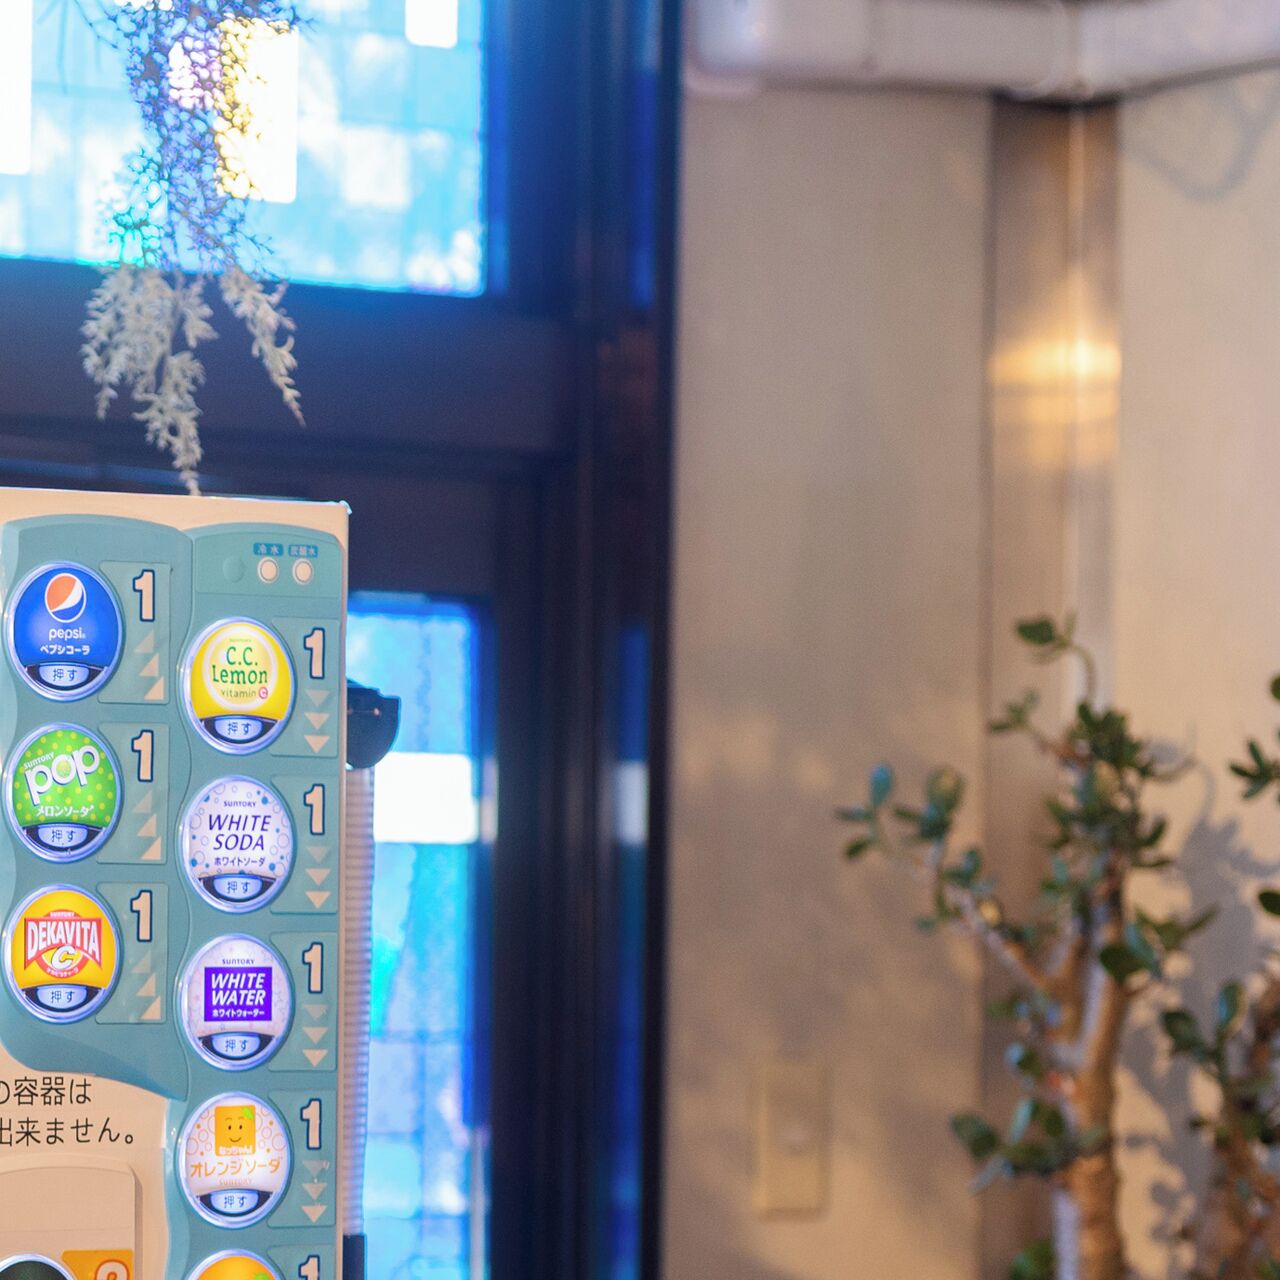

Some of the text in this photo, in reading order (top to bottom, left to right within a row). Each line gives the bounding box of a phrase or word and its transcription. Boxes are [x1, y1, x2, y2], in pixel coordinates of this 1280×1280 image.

[133, 569, 155, 622] 1
[48, 626, 82, 640] pepsi
[40, 644, 90, 656] ペプシコーラ
[226, 646, 258, 666] C.C.
[303, 628, 326, 680] 1
[53, 668, 78, 681] 押す
[212, 664, 268, 684] Lemon
[221, 688, 256, 698] vitamin
[228, 722, 252, 735] 押す
[132, 730, 154, 782] 1
[25, 745, 100, 806] pop
[36, 804, 94, 816] メロンソーダ
[303, 784, 326, 835] 1
[209, 814, 272, 832] WHITE
[52, 830, 76, 842] 押す
[213, 834, 264, 850] SODA
[214, 857, 266, 866] ホワイトソーダ
[227, 881, 250, 894] 押す
[130, 890, 152, 942] 1
[27, 921, 100, 962] DEKAVITA
[51, 944, 76, 970] C
[302, 942, 325, 994] 1
[212, 973, 266, 989] WHITE
[51, 990, 75, 1003] 押す
[212, 990, 266, 1006] WATER
[226, 1040, 248, 1052] 押す
[300, 1098, 322, 1150] 1
[190, 1157, 281, 1178] オレンジソーダ
[224, 1196, 247, 1208] 押す
